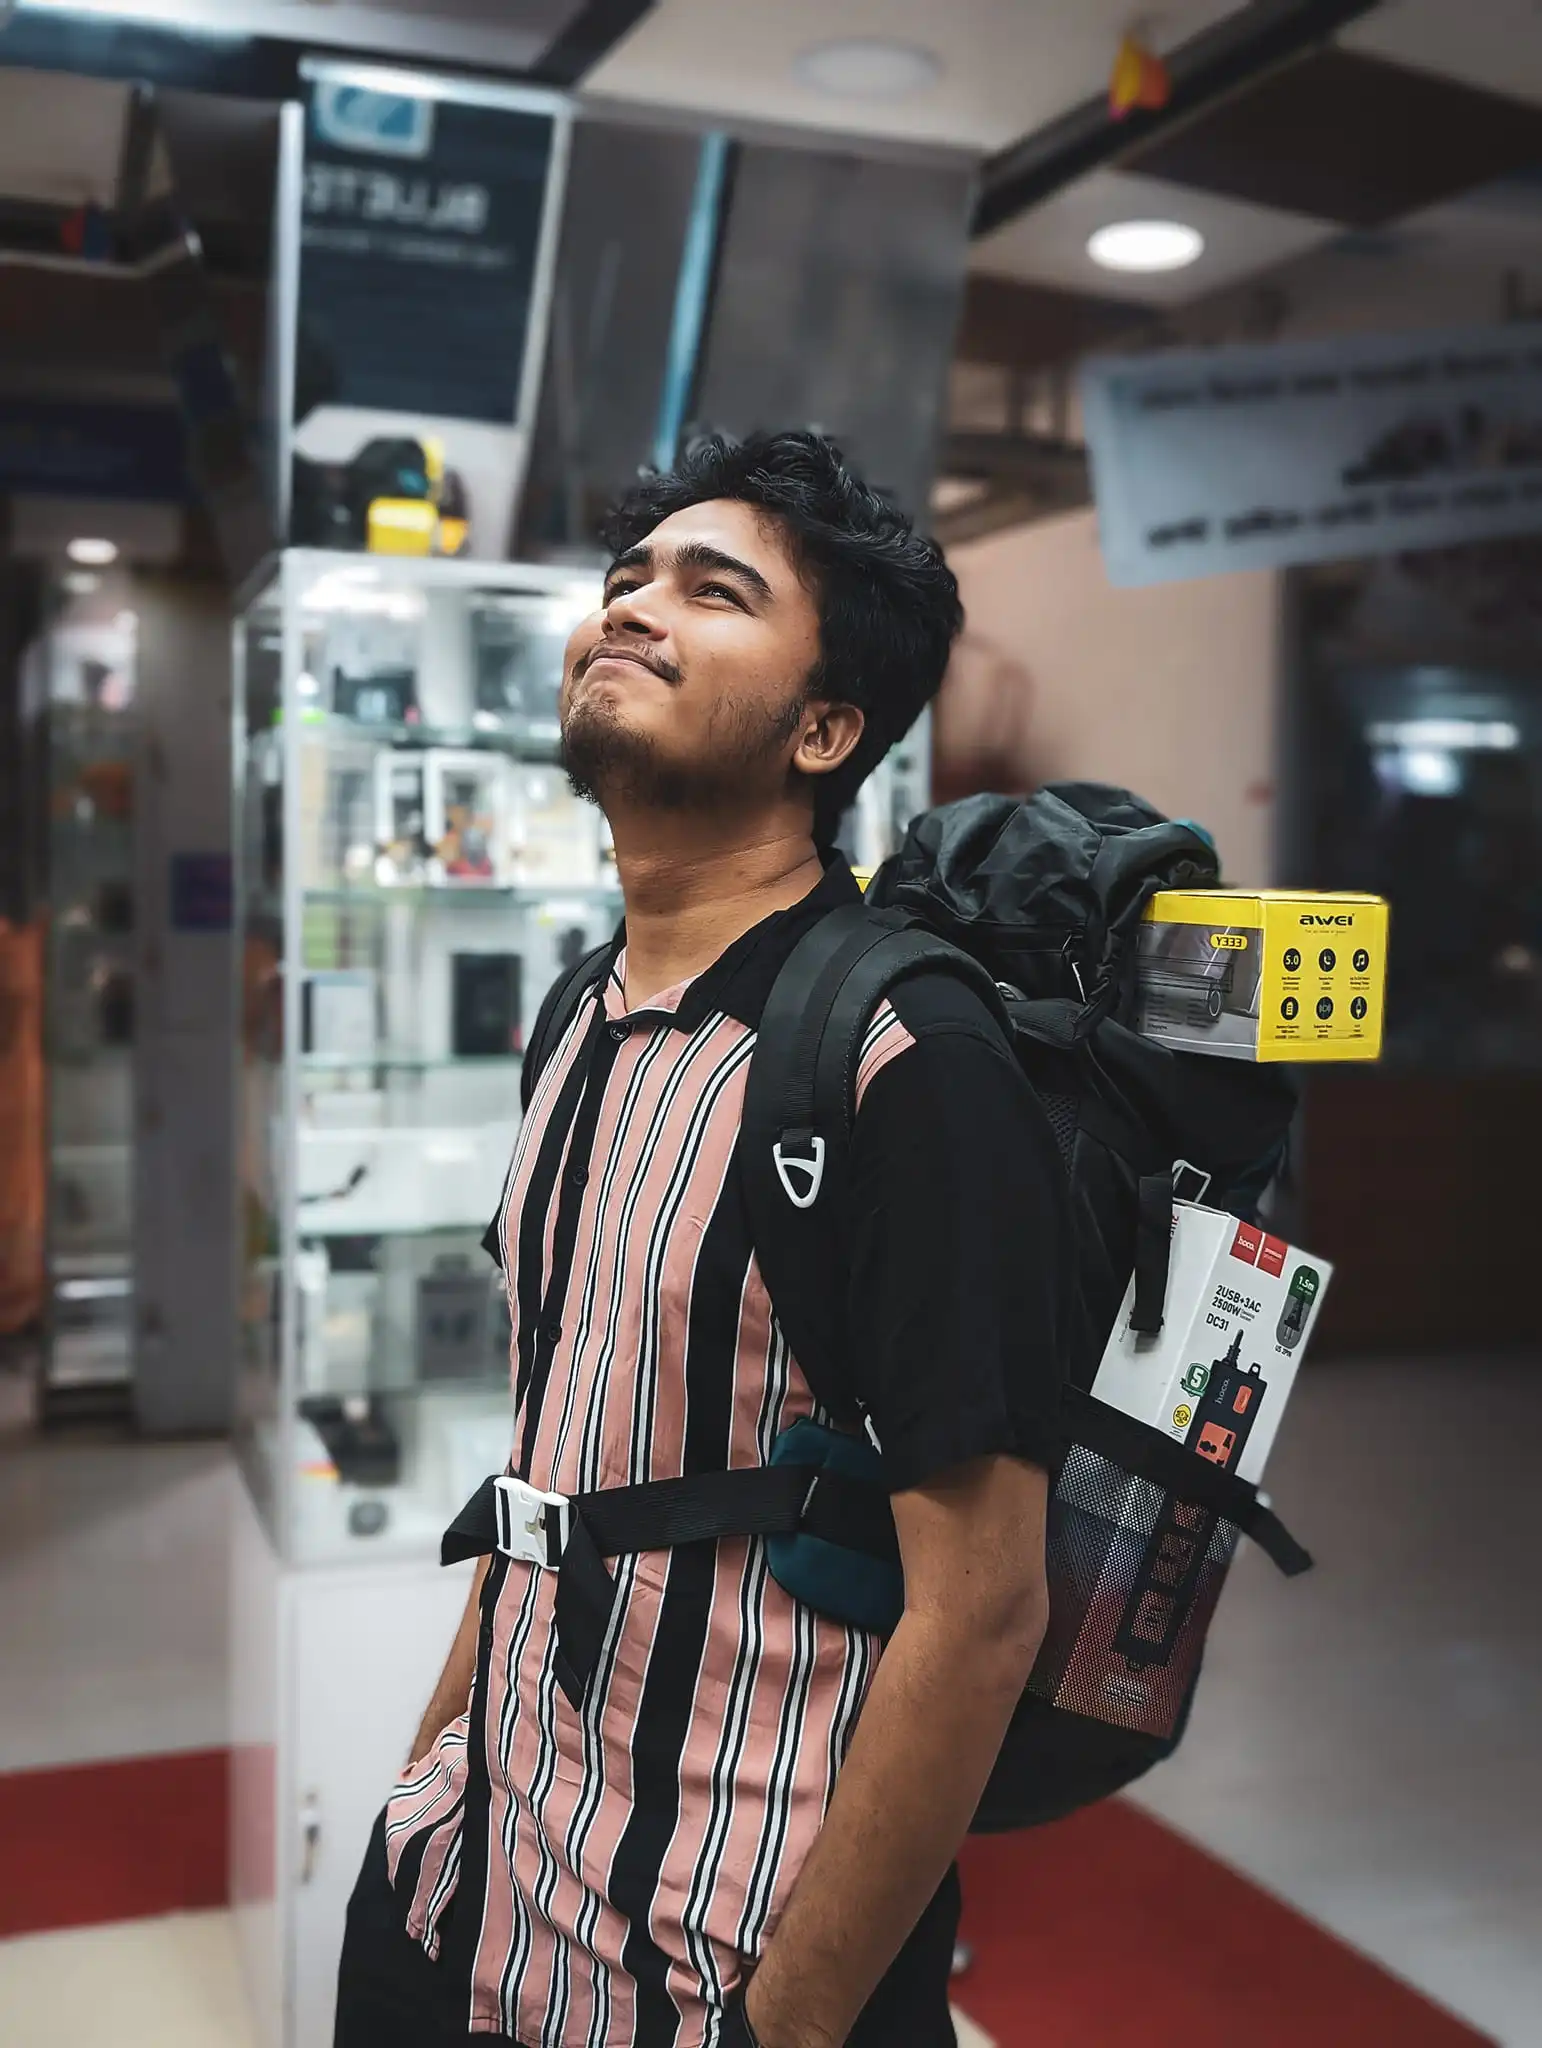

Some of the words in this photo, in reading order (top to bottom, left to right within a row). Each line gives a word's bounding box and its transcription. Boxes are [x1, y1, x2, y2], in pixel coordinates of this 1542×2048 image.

[1216, 937, 1242, 948] Y333
[1285, 955, 1299, 965] 5.0
[1211, 1296, 1242, 1317] 2500W
[1215, 1285, 1262, 1313] 2USB+3AC
[1205, 1313, 1230, 1332] DC31
